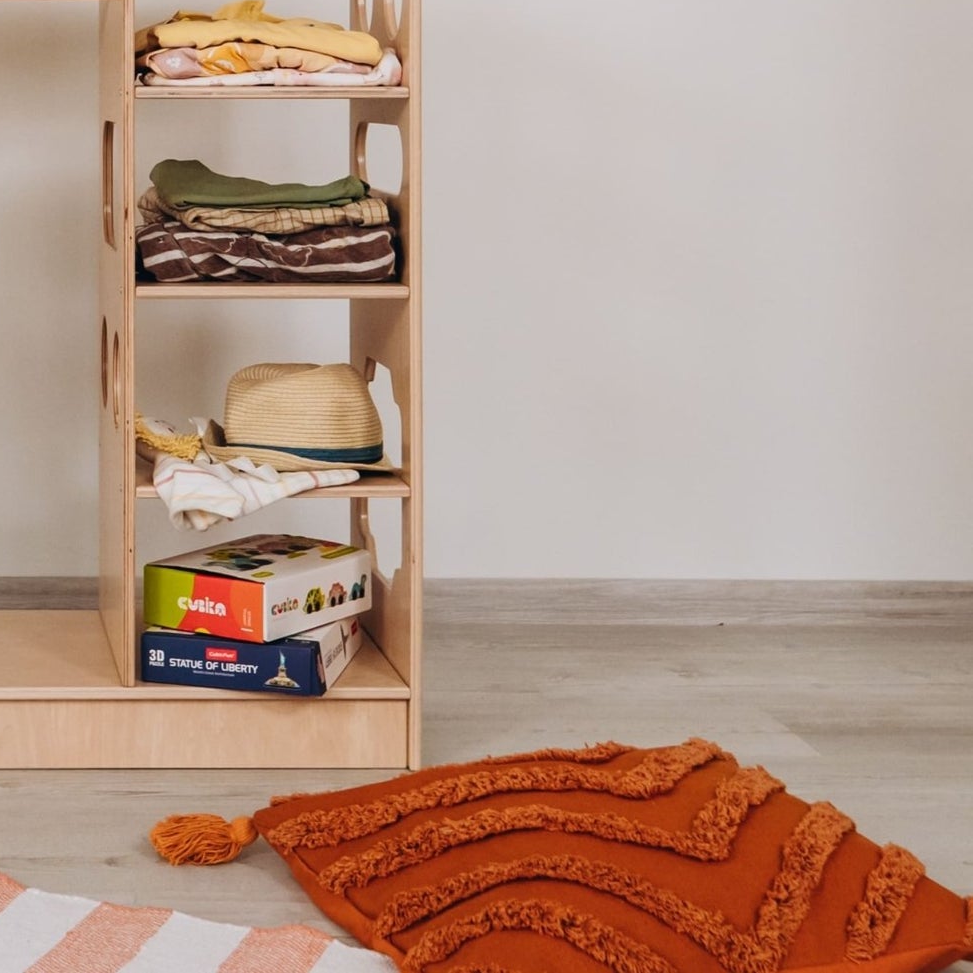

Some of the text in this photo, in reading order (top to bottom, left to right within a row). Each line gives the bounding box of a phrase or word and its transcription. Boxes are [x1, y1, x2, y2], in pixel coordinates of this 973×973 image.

[149, 649, 165, 662] 3D
[169, 658, 203, 670] STATUE
[205, 661, 219, 670] OF
[221, 663, 258, 674] LIBERTY
